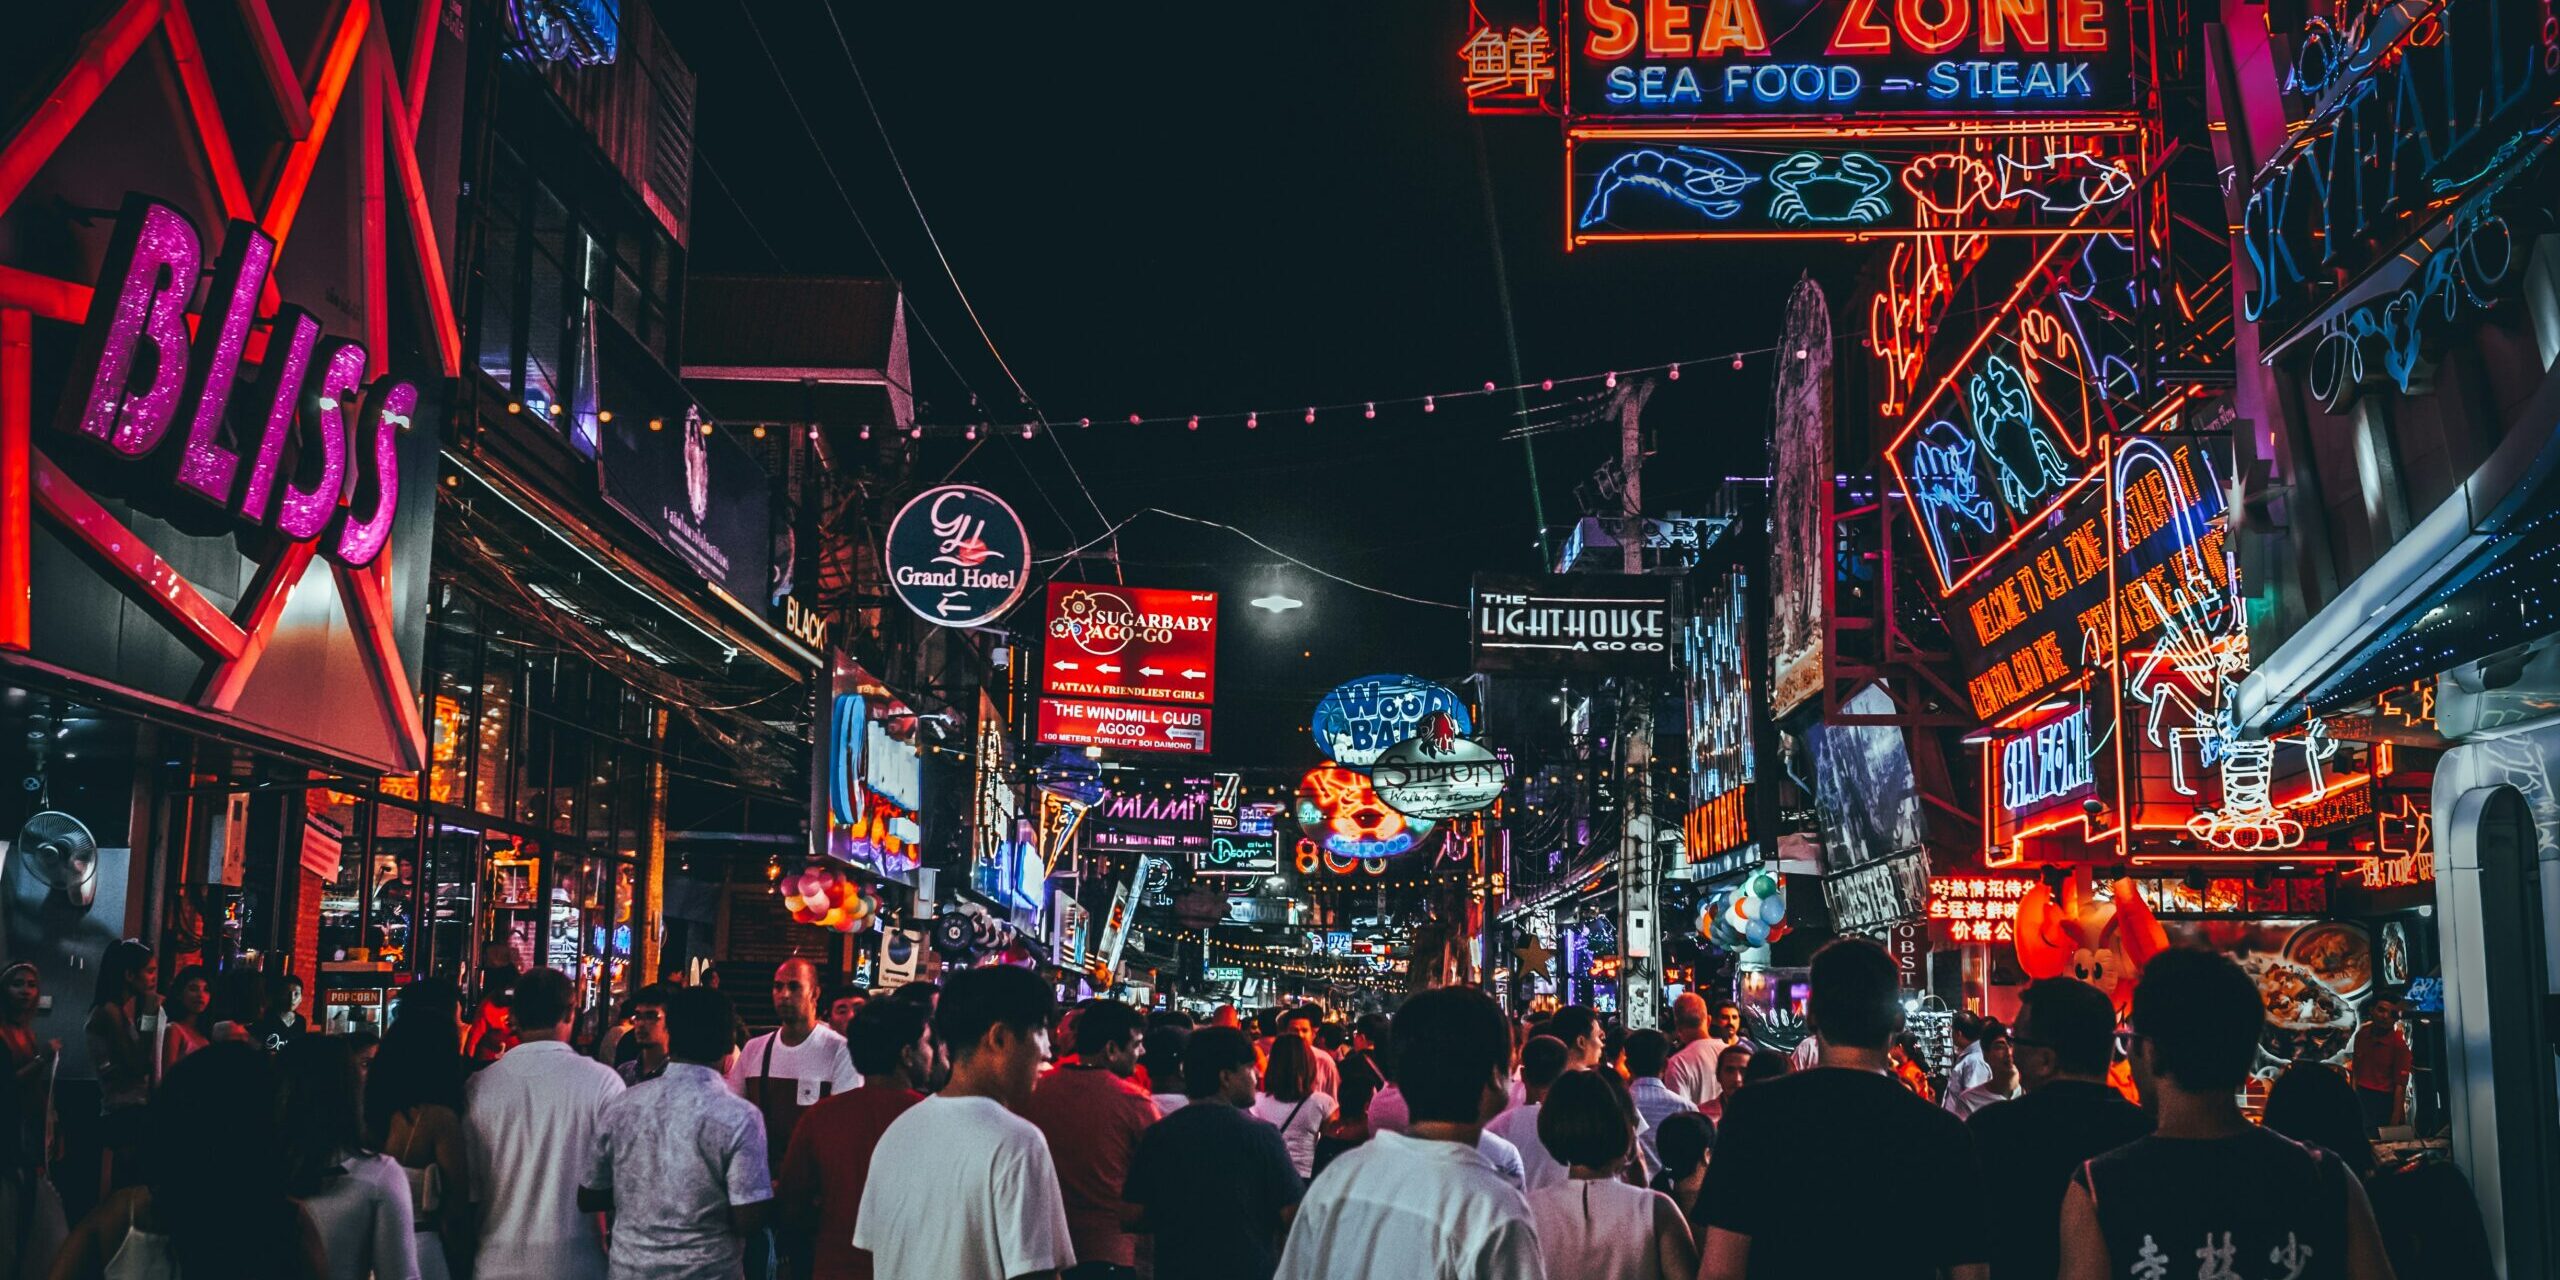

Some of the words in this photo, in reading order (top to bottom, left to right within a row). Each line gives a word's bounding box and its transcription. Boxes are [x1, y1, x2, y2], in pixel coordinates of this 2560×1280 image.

[1583, 0, 1771, 58] SEA
[1823, 0, 2108, 55] ZONE
[1606, 65, 1702, 102] SEA
[1724, 63, 1862, 101] FOOD
[1927, 62, 2092, 99] STEAK
[81, 203, 418, 567] BLISS
[896, 566, 957, 587] Grand
[962, 568, 1015, 589] Hotel
[1969, 577, 2028, 647] WELCOME
[2016, 565, 2043, 613] TO
[2037, 546, 2073, 600] SEA
[2064, 519, 2109, 585] ZONE
[1481, 593, 1527, 605] THE
[787, 596, 825, 650] BLACK
[1096, 611, 1212, 631] SUGARBABY
[1481, 607, 1664, 638] LIGHTHOUSE
[1091, 625, 1172, 643] AGO-GO
[1572, 641, 1589, 651] A
[1592, 641, 1626, 651] GO
[1630, 642, 1664, 652] GO
[1052, 681, 1100, 693] PATTAYA
[1103, 685, 1171, 698] FRIENDLIEST
[1173, 690, 1205, 700] GIRLS
[1054, 703, 1083, 718] THE
[1086, 706, 1159, 723] WINDMILL
[1162, 711, 1202, 725] CLUB
[1097, 722, 1145, 736] AGOGO
[1044, 732, 1057, 741] 100
[1059, 734, 1091, 743] METERS
[1094, 736, 1116, 745] TURN
[1117, 737, 1136, 746] LEFT
[1138, 738, 1152, 747] SOI
[1154, 740, 1191, 750] DAIMOND
[2004, 736, 2039, 810] SEA
[2037, 708, 2093, 799] ZONE
[1384, 756, 1494, 787] SIMON
[1106, 794, 1196, 820] MIAMI
[331, 992, 378, 1002] POPCORN
